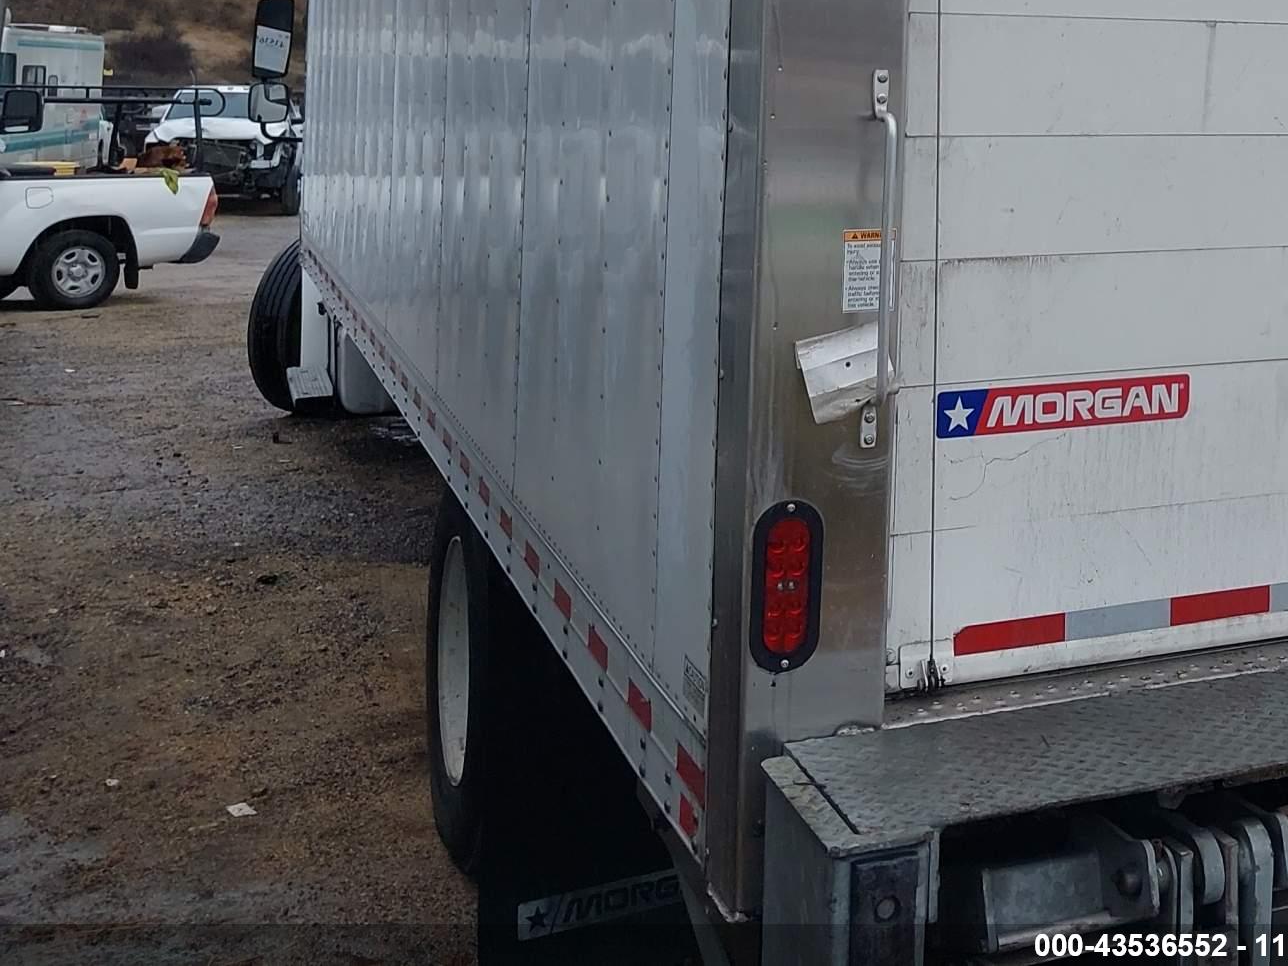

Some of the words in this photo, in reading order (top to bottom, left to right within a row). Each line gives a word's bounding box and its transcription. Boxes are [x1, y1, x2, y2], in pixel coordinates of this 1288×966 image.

[860, 232, 882, 240] WARN
[986, 383, 1180, 428] MORGAN
[564, 874, 681, 924] MORG
